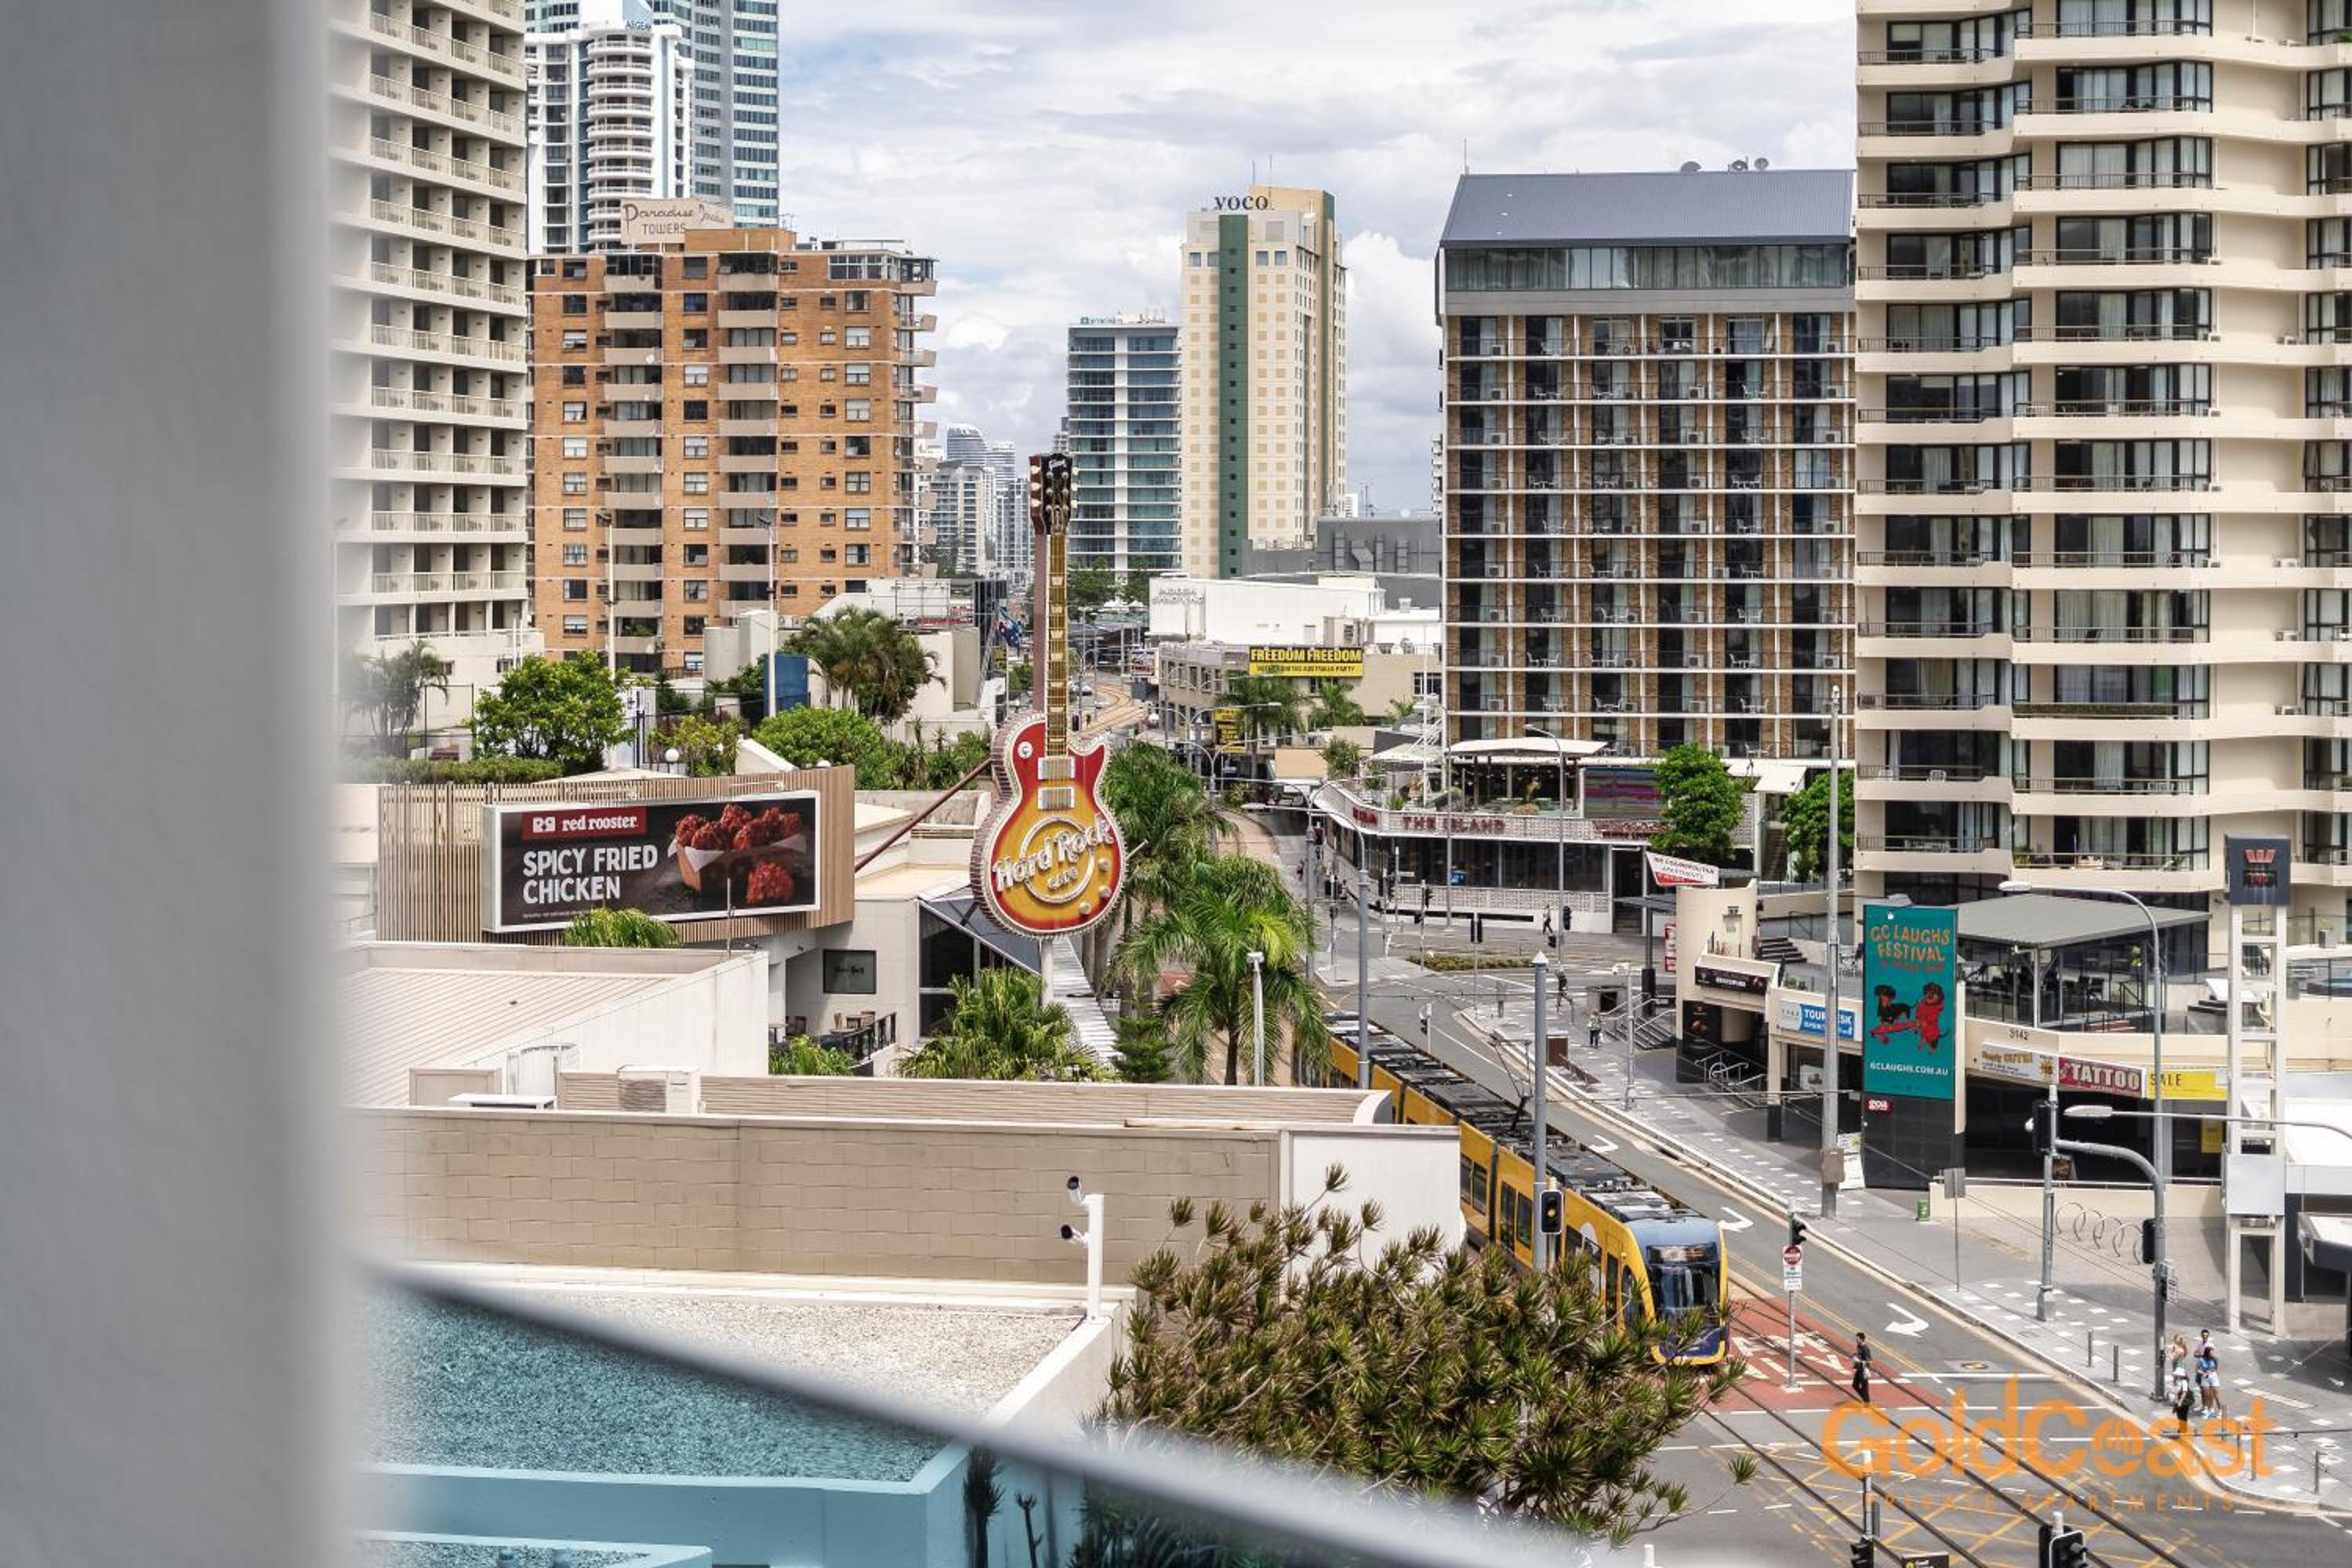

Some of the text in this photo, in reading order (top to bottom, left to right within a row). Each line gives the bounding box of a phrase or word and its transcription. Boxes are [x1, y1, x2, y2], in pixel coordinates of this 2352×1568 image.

[622, 203, 694, 230] Paradise
[642, 223, 688, 234] TOWERS
[1250, 648, 1362, 662] FREEDOM FREEDOM
[561, 815, 637, 832] red rooster
[1403, 816, 1436, 829] THE
[523, 844, 659, 877] SPICY FRIED
[993, 812, 1114, 892] Hard Rock
[523, 876, 620, 904] CHICKEN
[1893, 925, 1951, 946] LAUGHS
[1877, 942, 1945, 962] FESTIVAL
[2072, 1062, 2140, 1091] TATTOO
